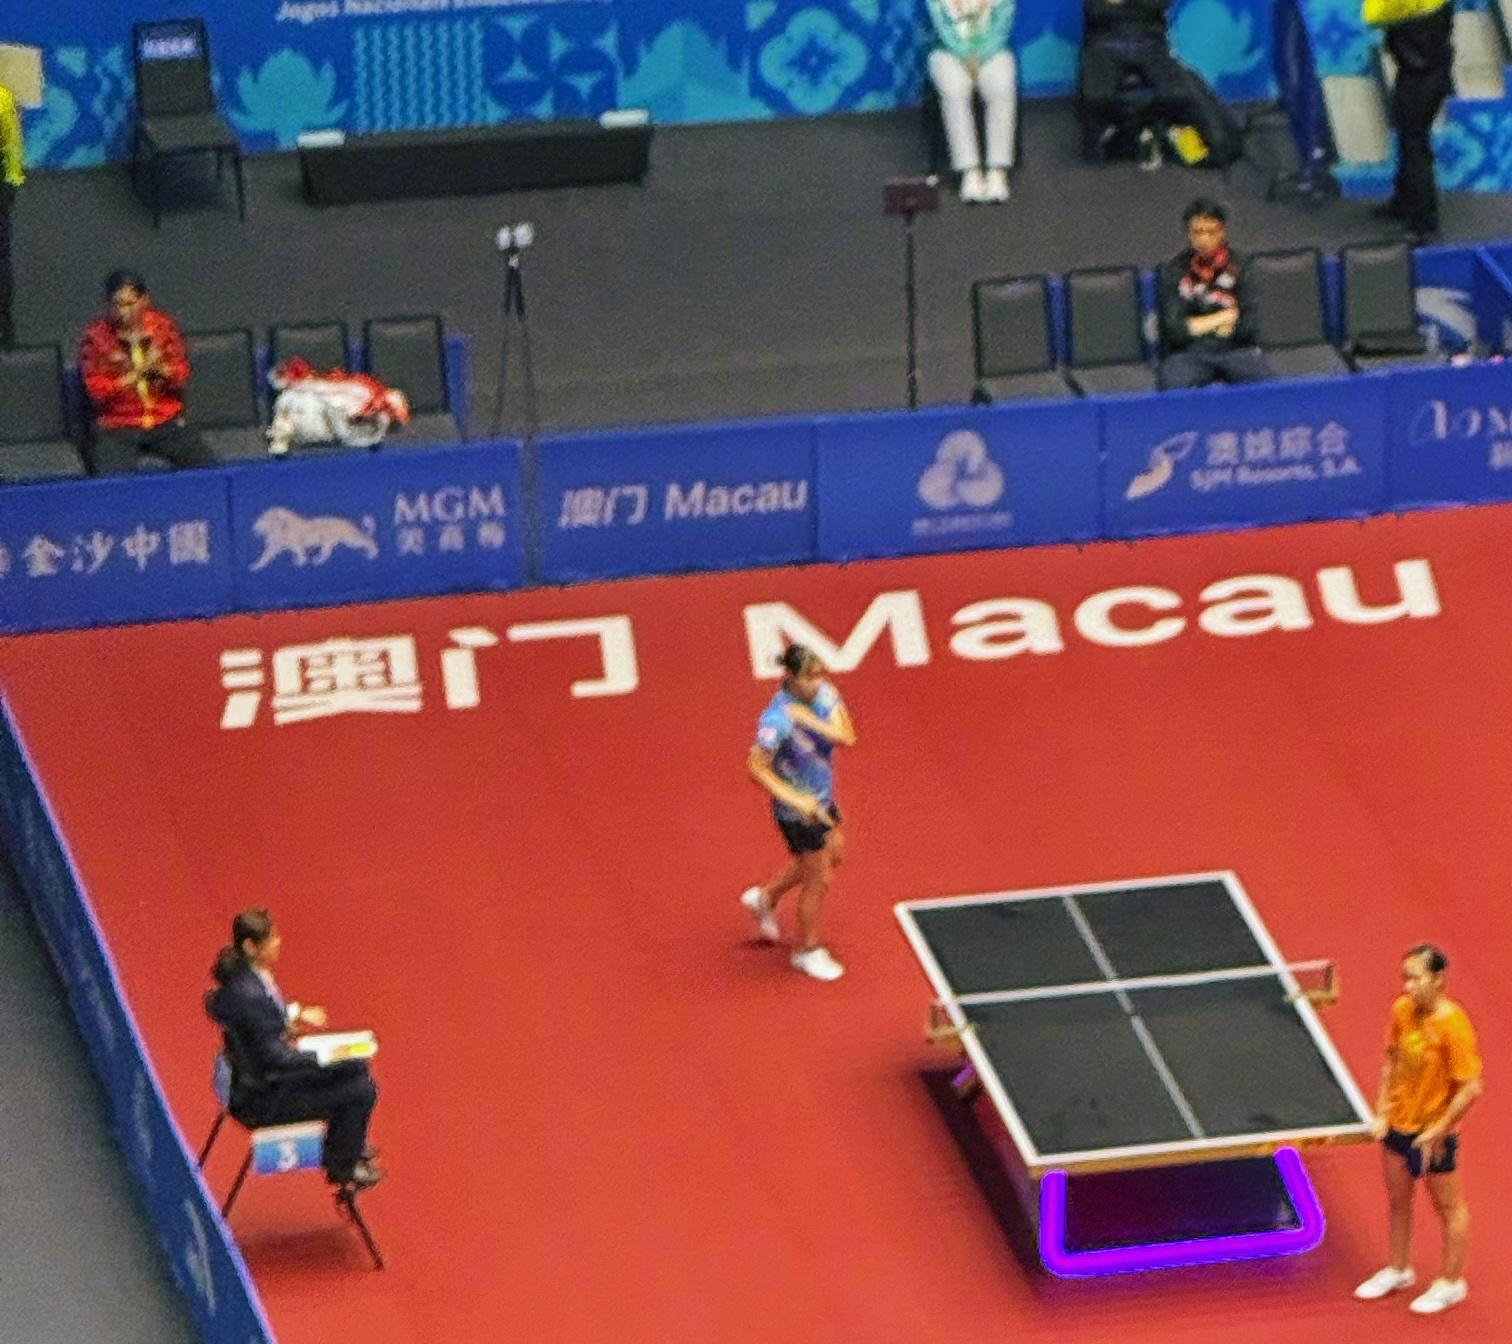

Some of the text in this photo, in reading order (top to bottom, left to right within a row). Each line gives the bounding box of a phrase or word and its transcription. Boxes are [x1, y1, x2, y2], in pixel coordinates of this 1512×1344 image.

[394, 485, 506, 525] MGM
[664, 479, 809, 520] Macau
[220, 558, 1441, 729] 澳门 Macau
